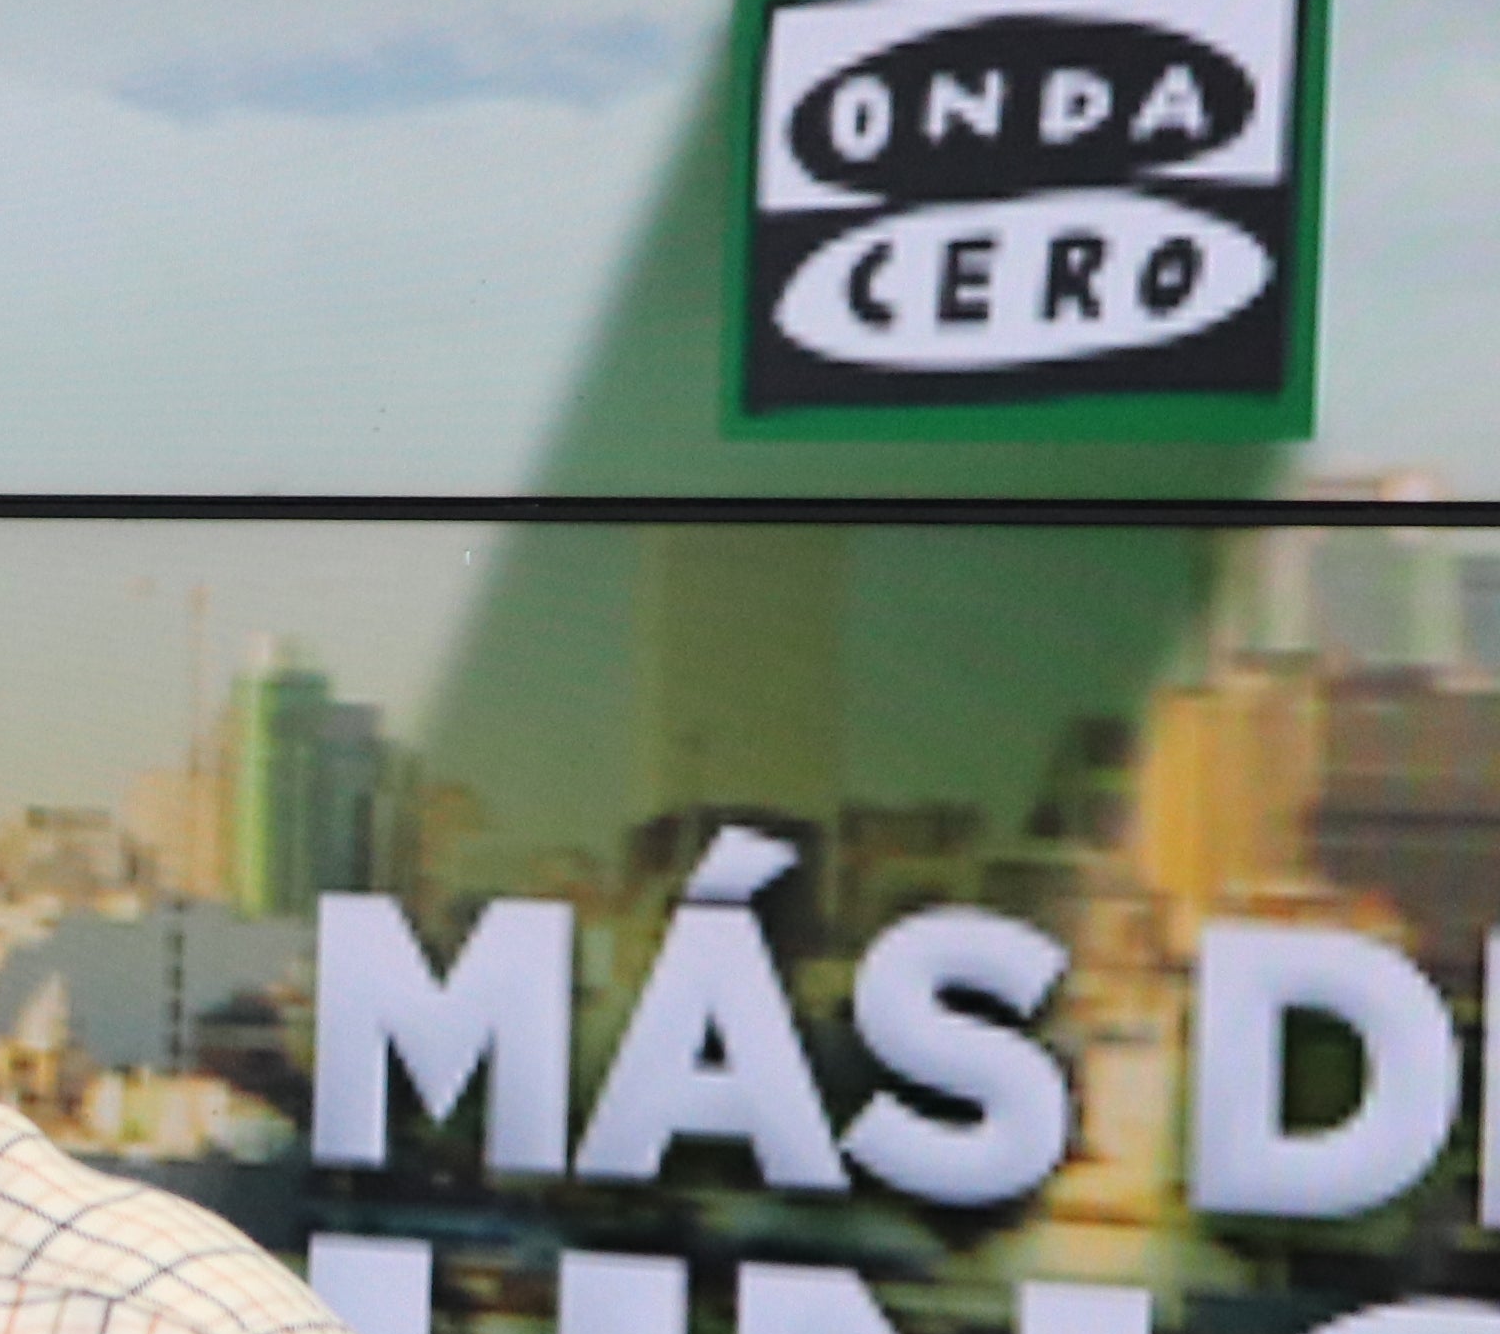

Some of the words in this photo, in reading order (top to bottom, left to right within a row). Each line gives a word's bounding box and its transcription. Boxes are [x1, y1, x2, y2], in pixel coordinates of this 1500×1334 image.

[831, 61, 1213, 163] ONDA
[846, 233, 1203, 327] CERO
[311, 827, 1071, 1209] MÁS
[1190, 921, 1500, 1227] D
